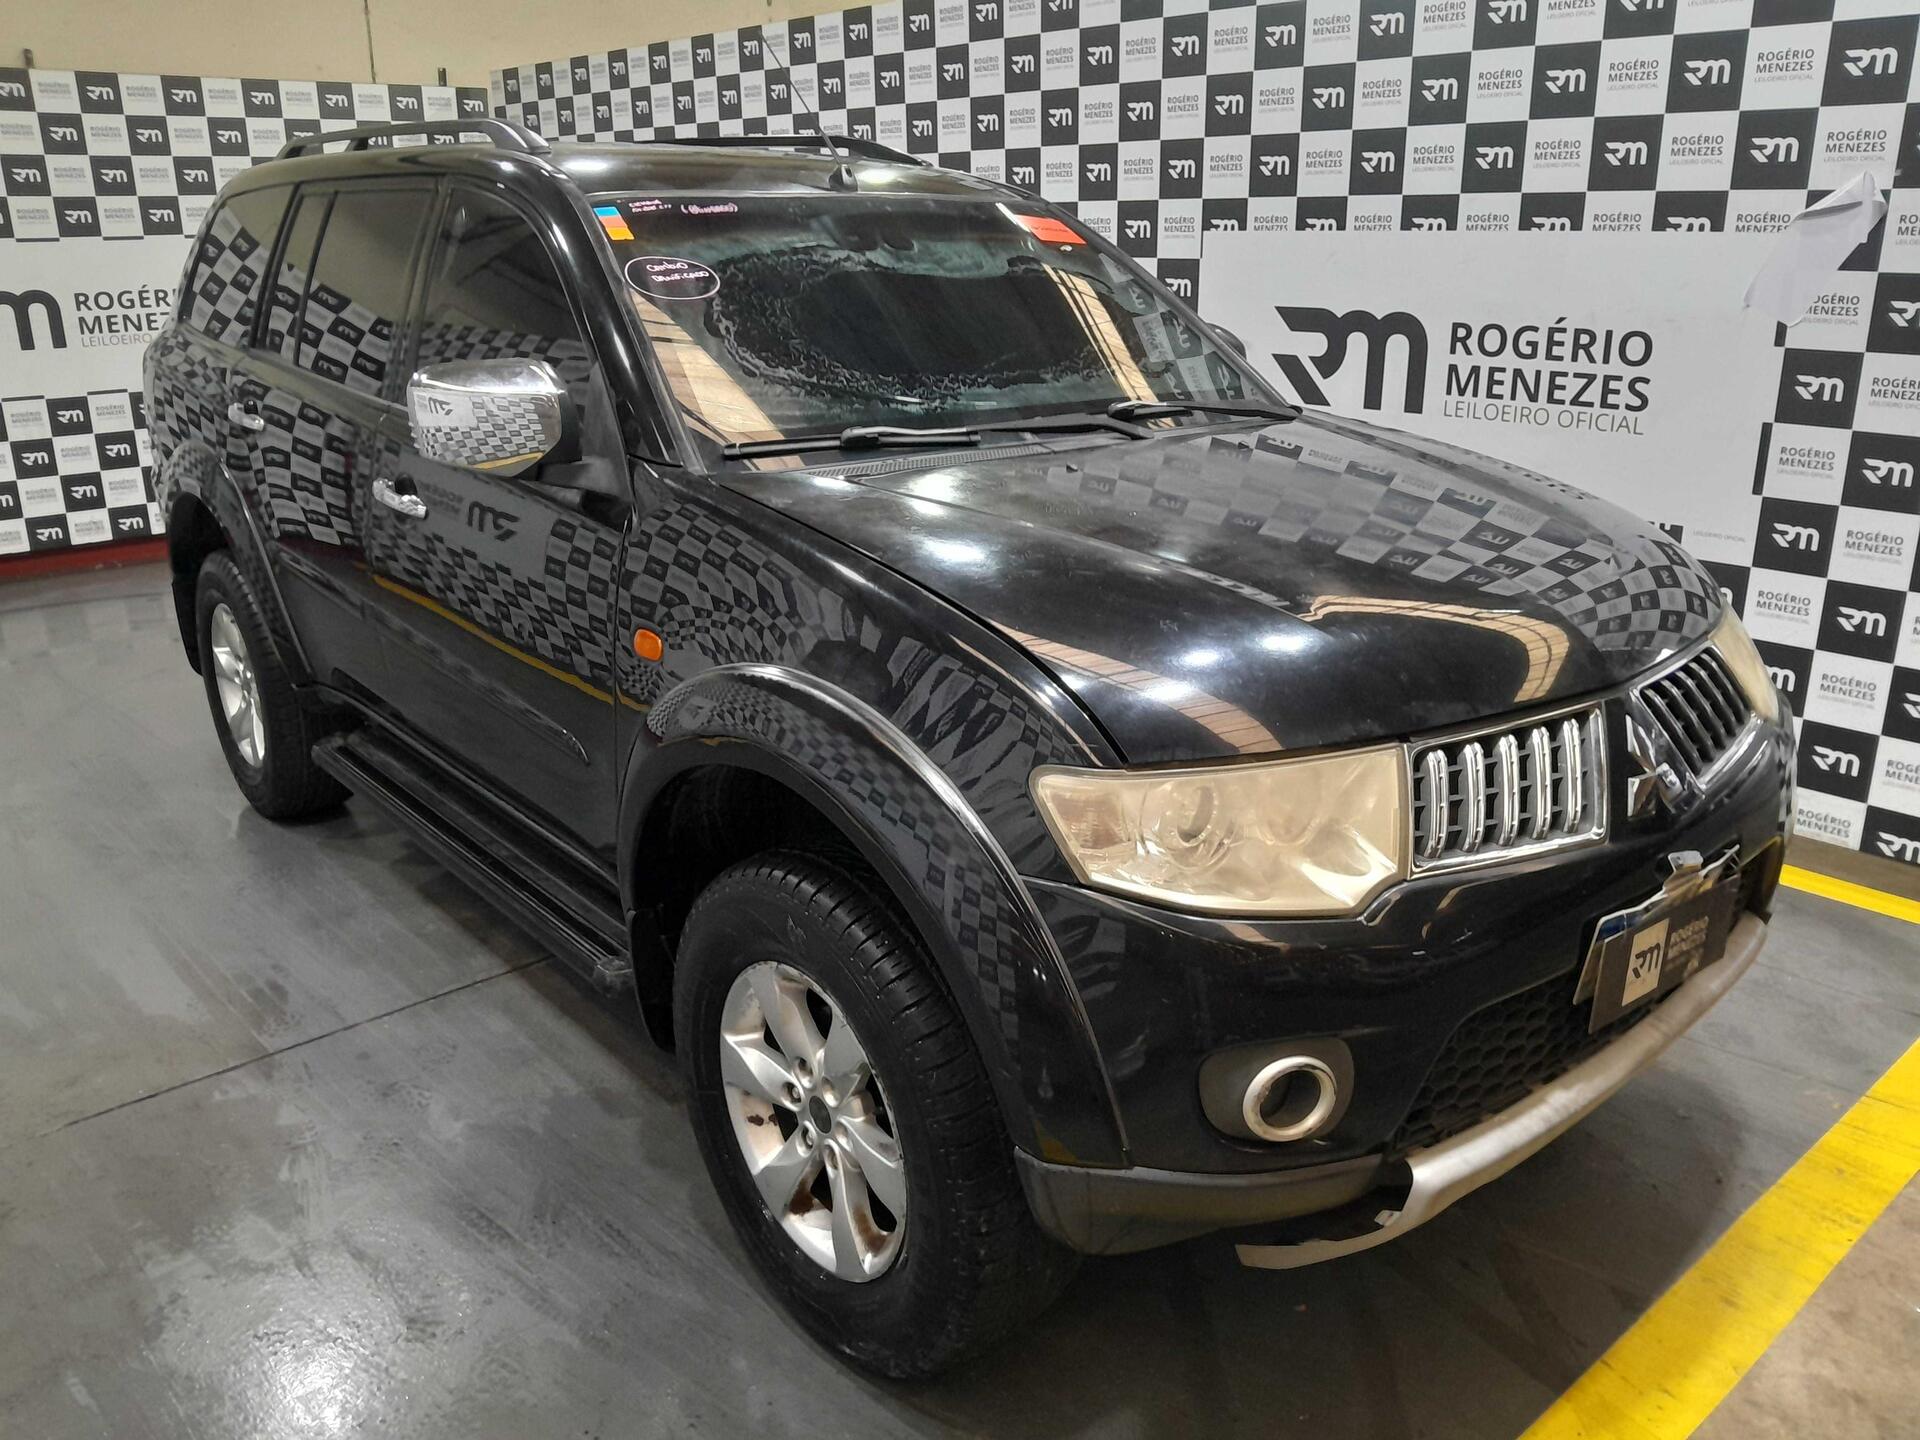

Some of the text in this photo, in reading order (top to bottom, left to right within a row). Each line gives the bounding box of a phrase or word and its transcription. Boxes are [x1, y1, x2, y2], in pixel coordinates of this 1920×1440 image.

[1423, 0, 1466, 14] ROGÉRIO
[1547, 0, 1596, 11] MENEZES
[1313, 13, 1350, 26] ROGÉRIO
[1422, 10, 1465, 24] MENEZES
[1214, 25, 1247, 37] ROGÉRIO
[1312, 23, 1350, 36] MENEZES
[1125, 36, 1155, 47] ROGÉRIO
[1214, 35, 1247, 46] MENEZES
[1046, 46, 1073, 56] ROGÉRIO
[1125, 45, 1156, 56] MENEZES
[1757, 47, 1815, 62] ROGÉRIO
[974, 54, 998, 64] ROGÉRIO
[1046, 54, 1073, 64] MENEZES
[974, 62, 999, 72] MENEZES
[1608, 58, 1659, 72] ROGÉRIO
[1755, 59, 1813, 73] MENEZES
[1478, 68, 1522, 81] ROGÉRIO
[1607, 70, 1658, 82] MENEZES
[1362, 77, 1401, 90] ROGÉRIO
[1477, 79, 1522, 91] MENEZES
[1259, 86, 1294, 97] ROGÉRIO
[1361, 88, 1401, 99] MENEZES
[1167, 93, 1198, 104] ROGÉRIO
[1259, 96, 1294, 106] MENEZES
[1084, 100, 1112, 111] ROGÉRIO
[1167, 103, 1198, 112] MENEZES
[1009, 107, 1035, 116] ROGÉRIO
[1084, 109, 1112, 119] MENEZES
[1009, 115, 1035, 124] MENEZES
[1671, 133, 1723, 146] ROGÉRIO
[1826, 127, 1887, 141] ROGÉRIO
[1413, 143, 1454, 155] ROGÉRIO
[1534, 138, 1581, 150] ROGÉRIO
[1824, 141, 1886, 153] MENEZES
[1306, 148, 1342, 159] ROGÉRIO
[1533, 150, 1580, 160] MENEZES
[1669, 146, 1722, 156] MENEZES
[1123, 157, 1153, 166] ROGÉRIO
[1210, 152, 1242, 163] ROGÉRIO
[1412, 154, 1454, 164] MENEZES
[1046, 160, 1072, 170] ROGÉRIO
[1209, 162, 1242, 171] MENEZES
[1305, 159, 1342, 168] MENEZES
[1046, 169, 1072, 177] MENEZES
[1123, 166, 1153, 174] MENEZES
[1164, 215, 1194, 224] ROGÉRIO
[1254, 214, 1288, 223] ROGÉRIO
[1354, 213, 1392, 223] ROGÉRIO
[1466, 212, 1509, 222] ROGÉRIO
[1593, 211, 1641, 222] ROGÉRIO
[1735, 211, 1791, 223] ROGÉRIO
[1814, 292, 1860, 305] GÉRIO
[1449, 317, 1653, 367] ROGÉRIO
[1445, 363, 1652, 413] MENEZES
[1871, 376, 1920, 390] ROGÉRI
[1869, 387, 1920, 401] MENEZE
[1443, 400, 1644, 436] LEILOEIRO OFICIAL
[1779, 446, 1835, 460] ROGÉRIO
[1777, 456, 1834, 470] MENEZES
[1845, 529, 1904, 546] ROGÉRIO
[1843, 539, 1903, 556] MENEZES
[1757, 589, 1810, 606] ROGÉRIO
[1755, 598, 1809, 616] MENEZES
[1818, 682, 1875, 701] MENEZES
[1795, 816, 1849, 838] MENEZES
